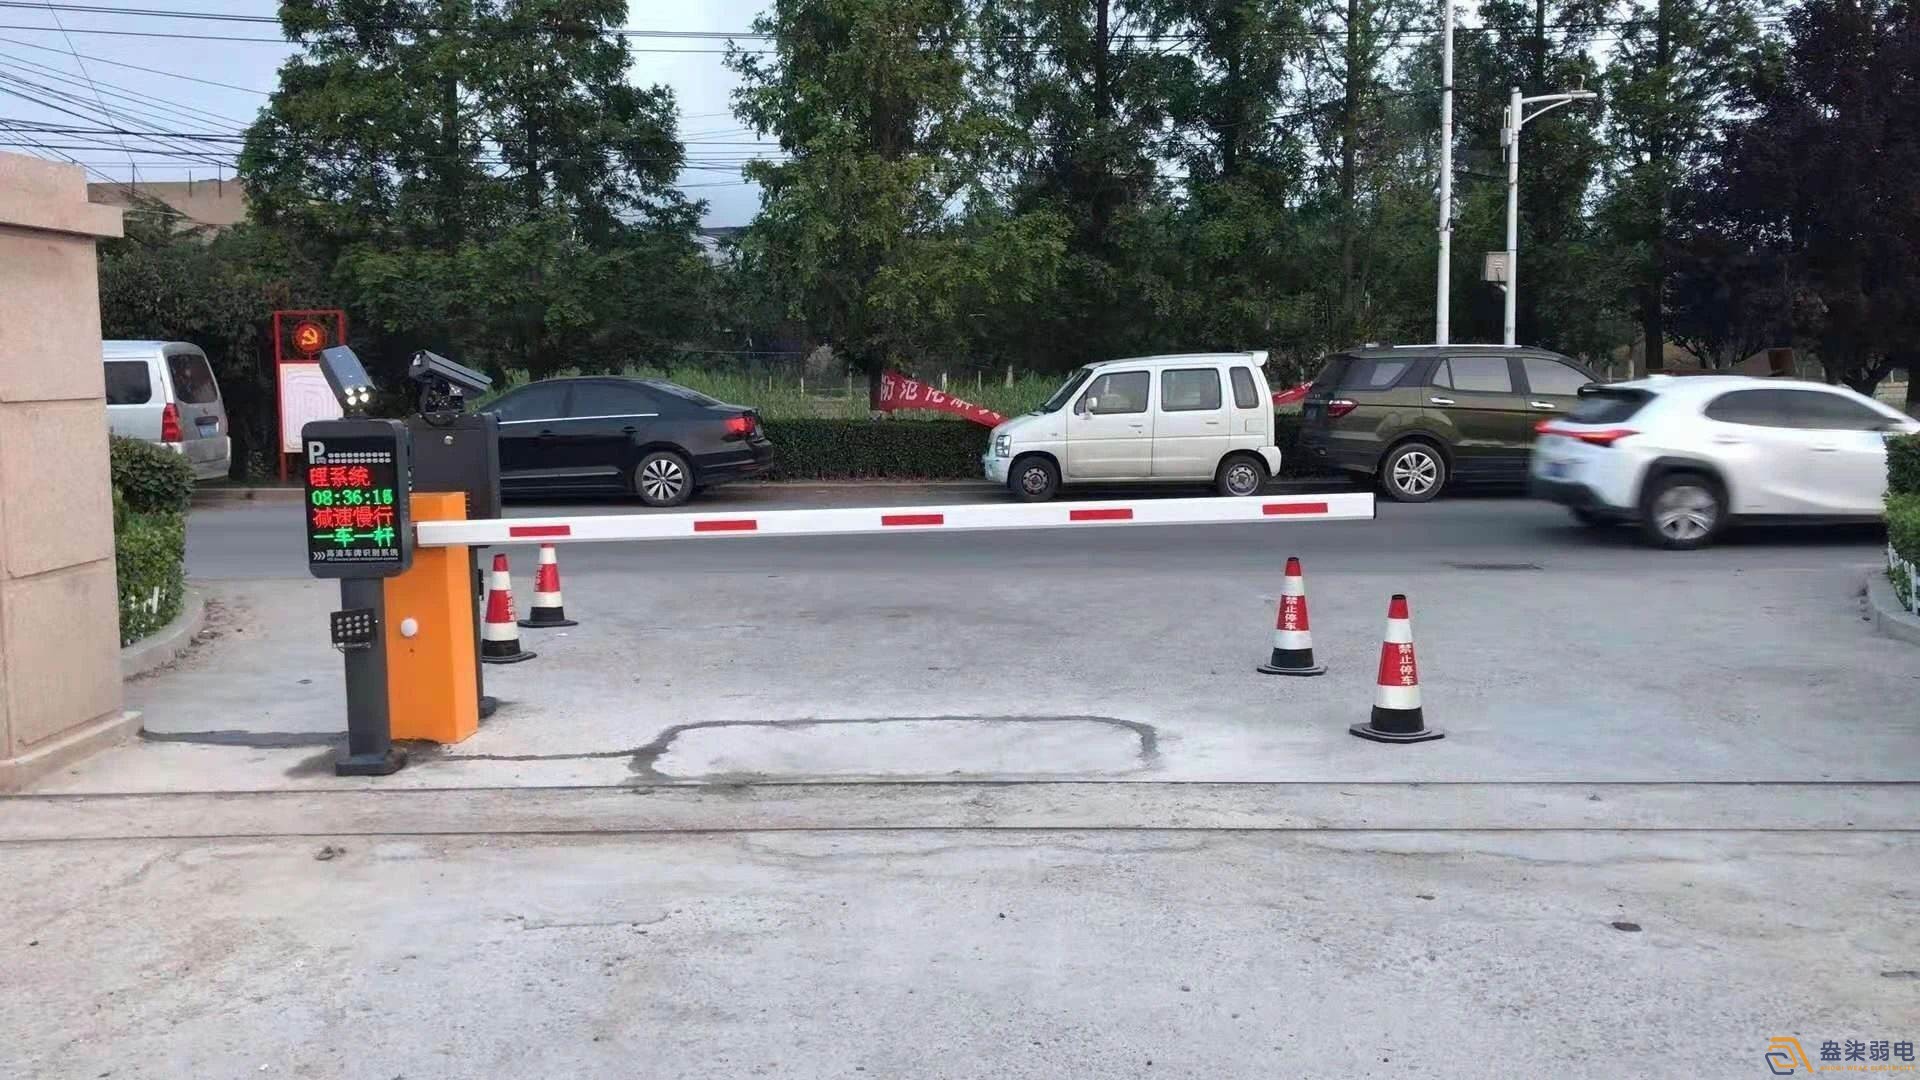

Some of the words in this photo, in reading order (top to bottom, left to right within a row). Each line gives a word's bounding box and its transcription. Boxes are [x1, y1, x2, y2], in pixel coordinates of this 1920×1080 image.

[308, 441, 325, 464] P
[313, 506, 392, 528] 减速慢行
[313, 527, 394, 547] 一车一杆
[1285, 597, 1297, 630] 禁止停车
[1399, 644, 1413, 685] 禁止停车
